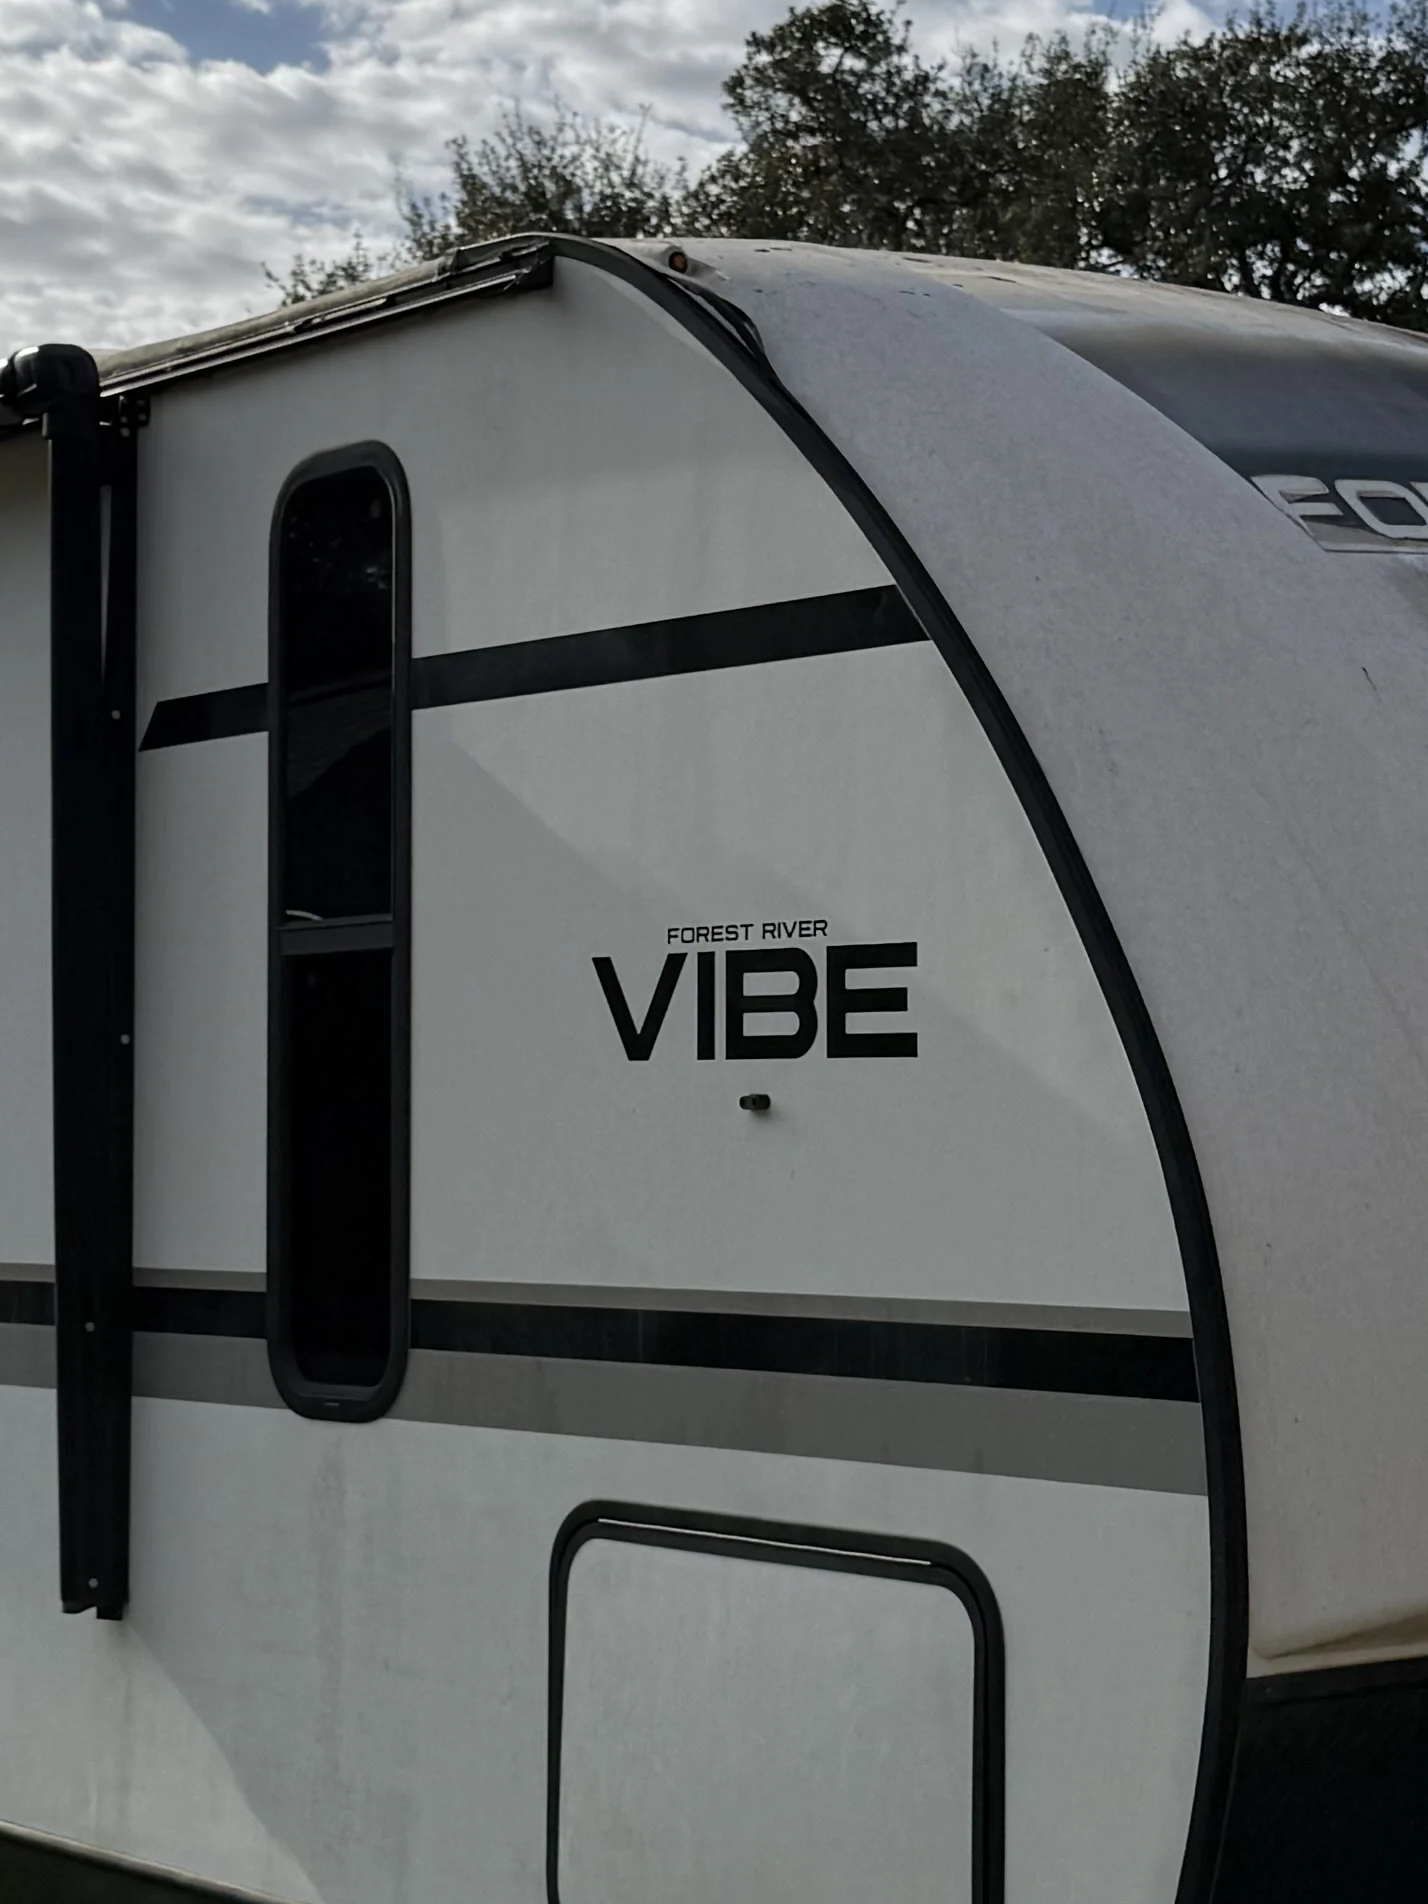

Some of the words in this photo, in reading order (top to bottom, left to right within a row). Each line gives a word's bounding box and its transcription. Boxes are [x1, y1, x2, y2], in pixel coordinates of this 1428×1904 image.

[667, 923, 755, 945] FOREST
[762, 919, 828, 940] RIVER
[591, 942, 919, 1061] VIBE
